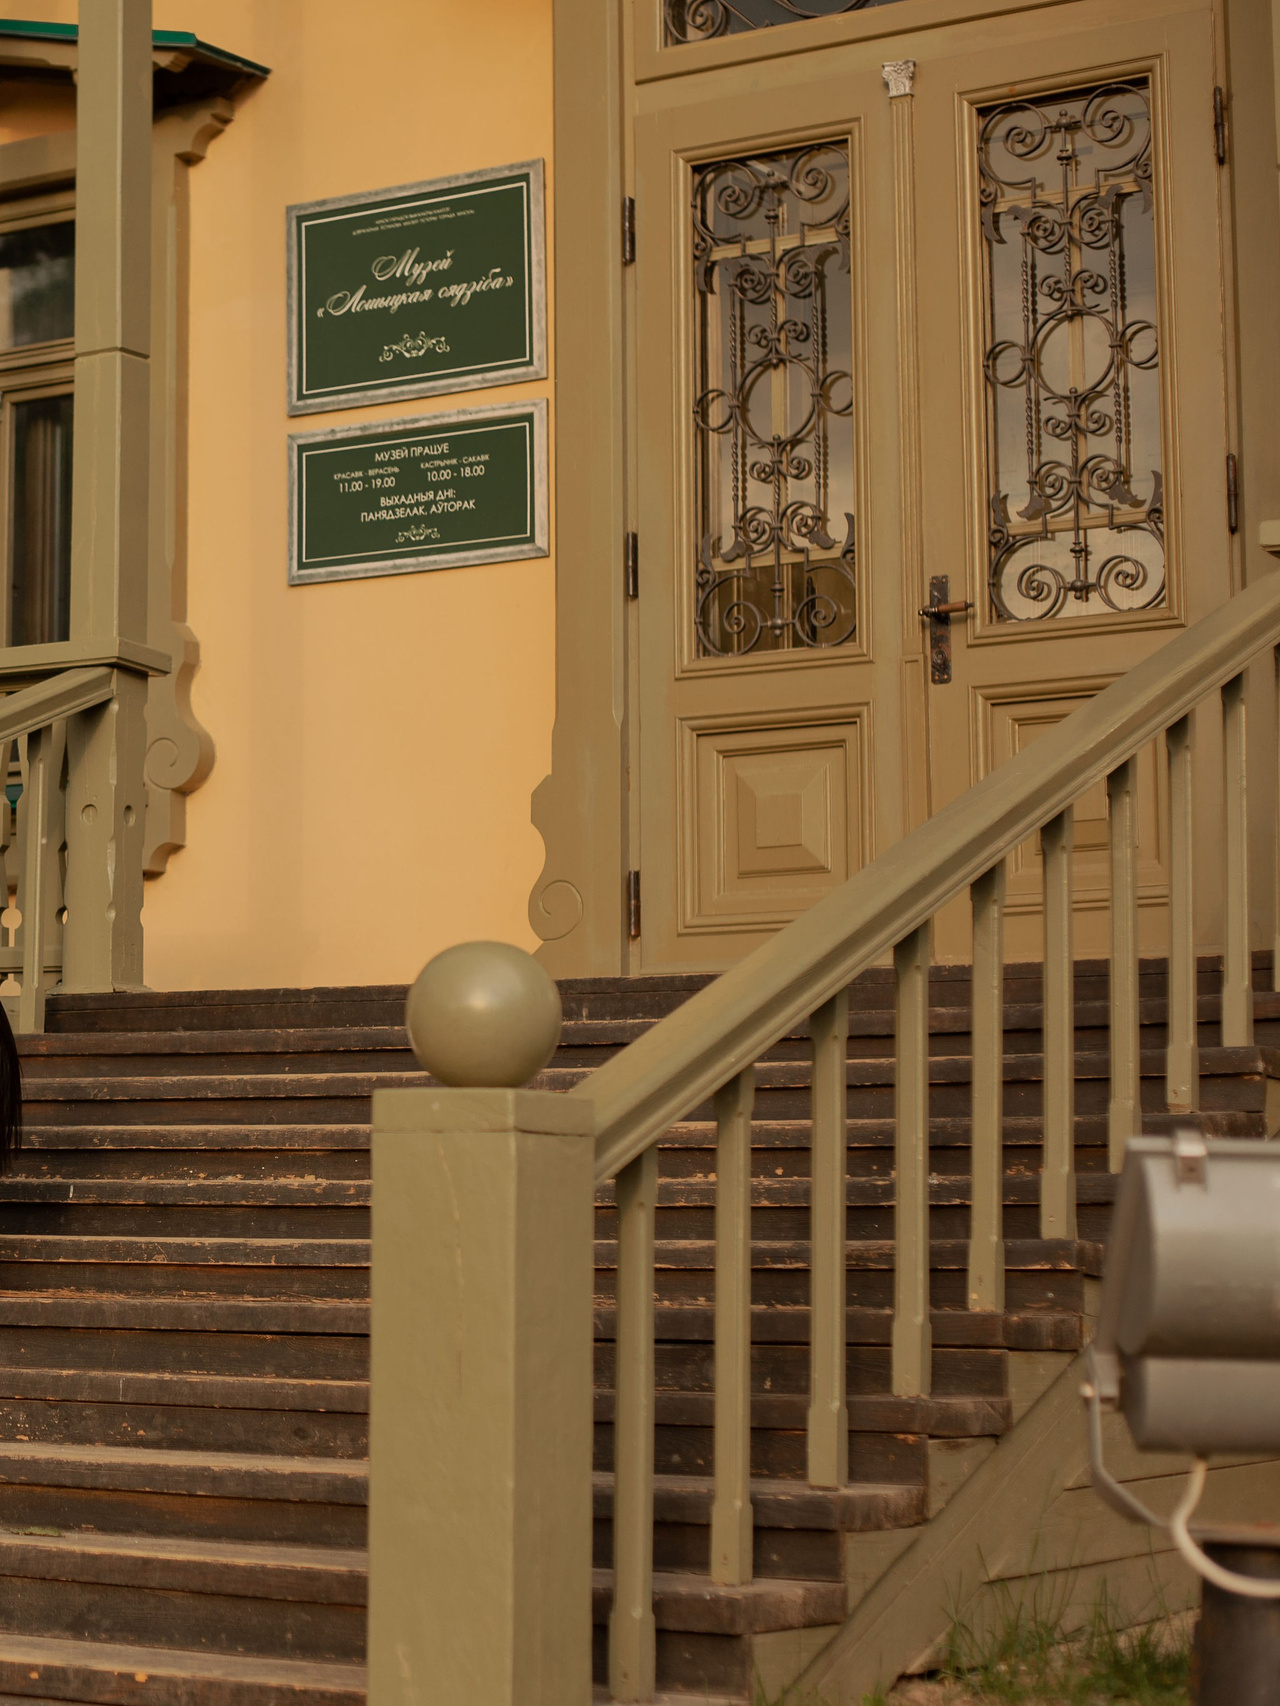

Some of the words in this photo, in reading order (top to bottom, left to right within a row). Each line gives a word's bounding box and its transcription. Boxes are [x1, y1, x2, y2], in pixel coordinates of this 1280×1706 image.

[371, 247, 456, 287] Музей
[374, 446, 409, 463] МУЗЕЙ
[410, 442, 450, 459] ПРАЦУЕ
[426, 469, 452, 482] 10.00
[460, 464, 486, 478] 18.00
[338, 480, 363, 494] 11.00
[371, 476, 396, 490] 19.00
[380, 490, 434, 507] ВЫХАДНЫЯ
[435, 488, 457, 502] ДНІ:
[360, 505, 428, 523] ПАНЯДЗЕЛАК,
[429, 498, 476, 516] АЎТОРАК
